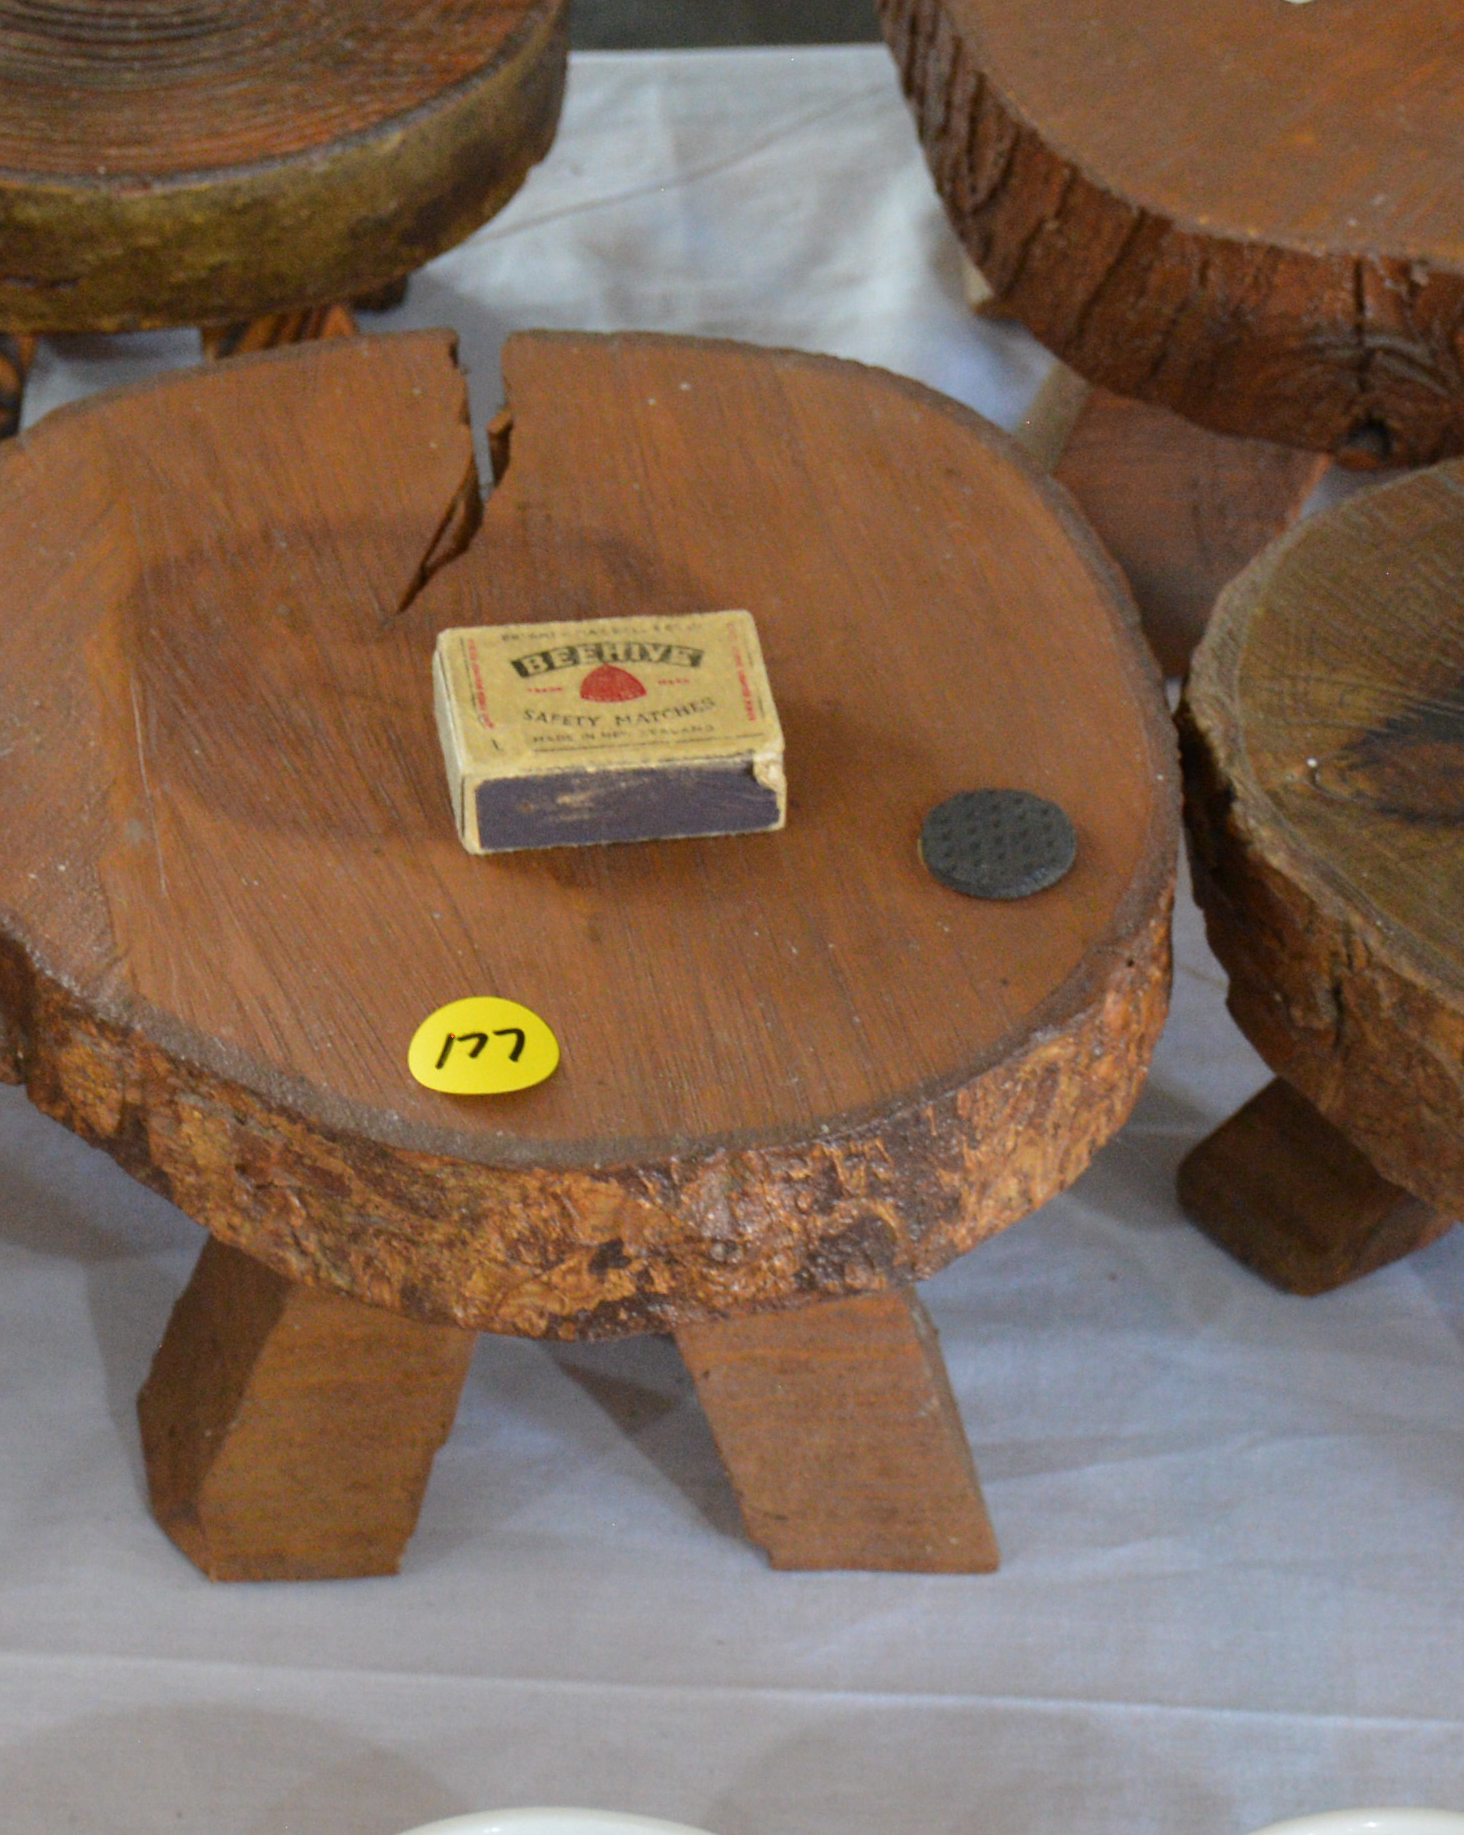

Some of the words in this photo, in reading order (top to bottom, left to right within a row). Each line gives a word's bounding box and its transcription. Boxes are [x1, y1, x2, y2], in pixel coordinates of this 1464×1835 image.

[515, 642, 700, 677] BEEHIVE
[523, 708, 600, 727] SAFETY
[614, 696, 716, 727] MATCHES
[435, 1027, 526, 1070] 177
